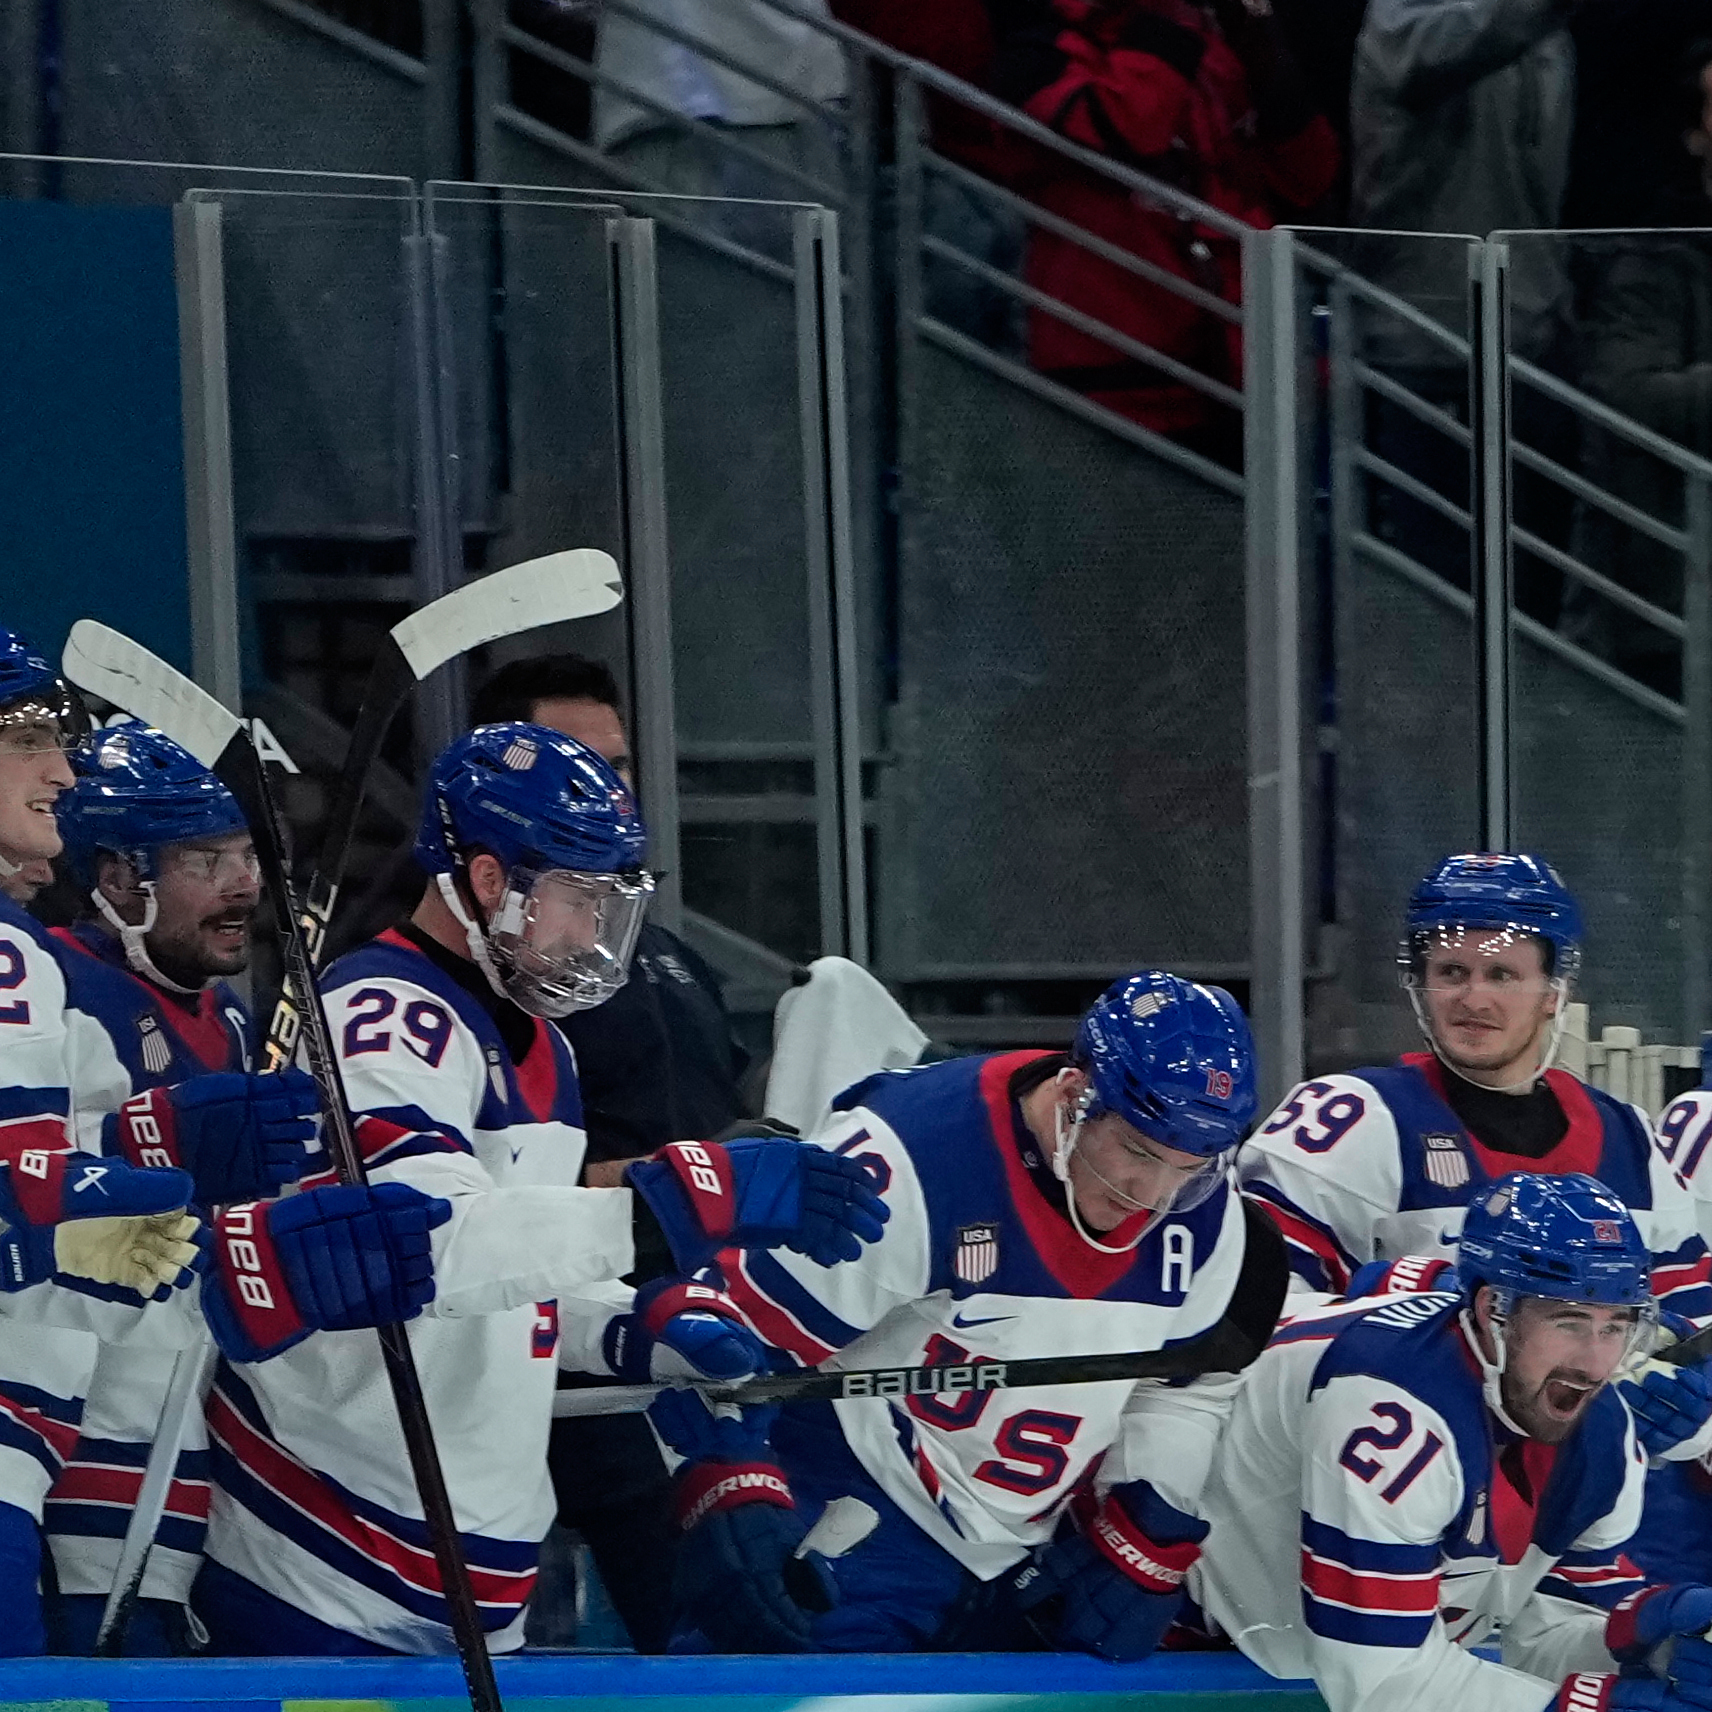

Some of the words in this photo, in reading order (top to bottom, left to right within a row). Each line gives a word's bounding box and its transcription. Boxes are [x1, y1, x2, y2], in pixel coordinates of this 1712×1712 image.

[343, 987, 454, 1069] 29
[1205, 1068, 1234, 1100] 19
[1262, 1081, 1366, 1154] 59
[1428, 1137, 1457, 1150] USA
[962, 1228, 993, 1244] USA
[1161, 1223, 1195, 1293] A
[1591, 1219, 1623, 1243] 21
[904, 1332, 1106, 1524] US
[1337, 1401, 1444, 1505] 21
